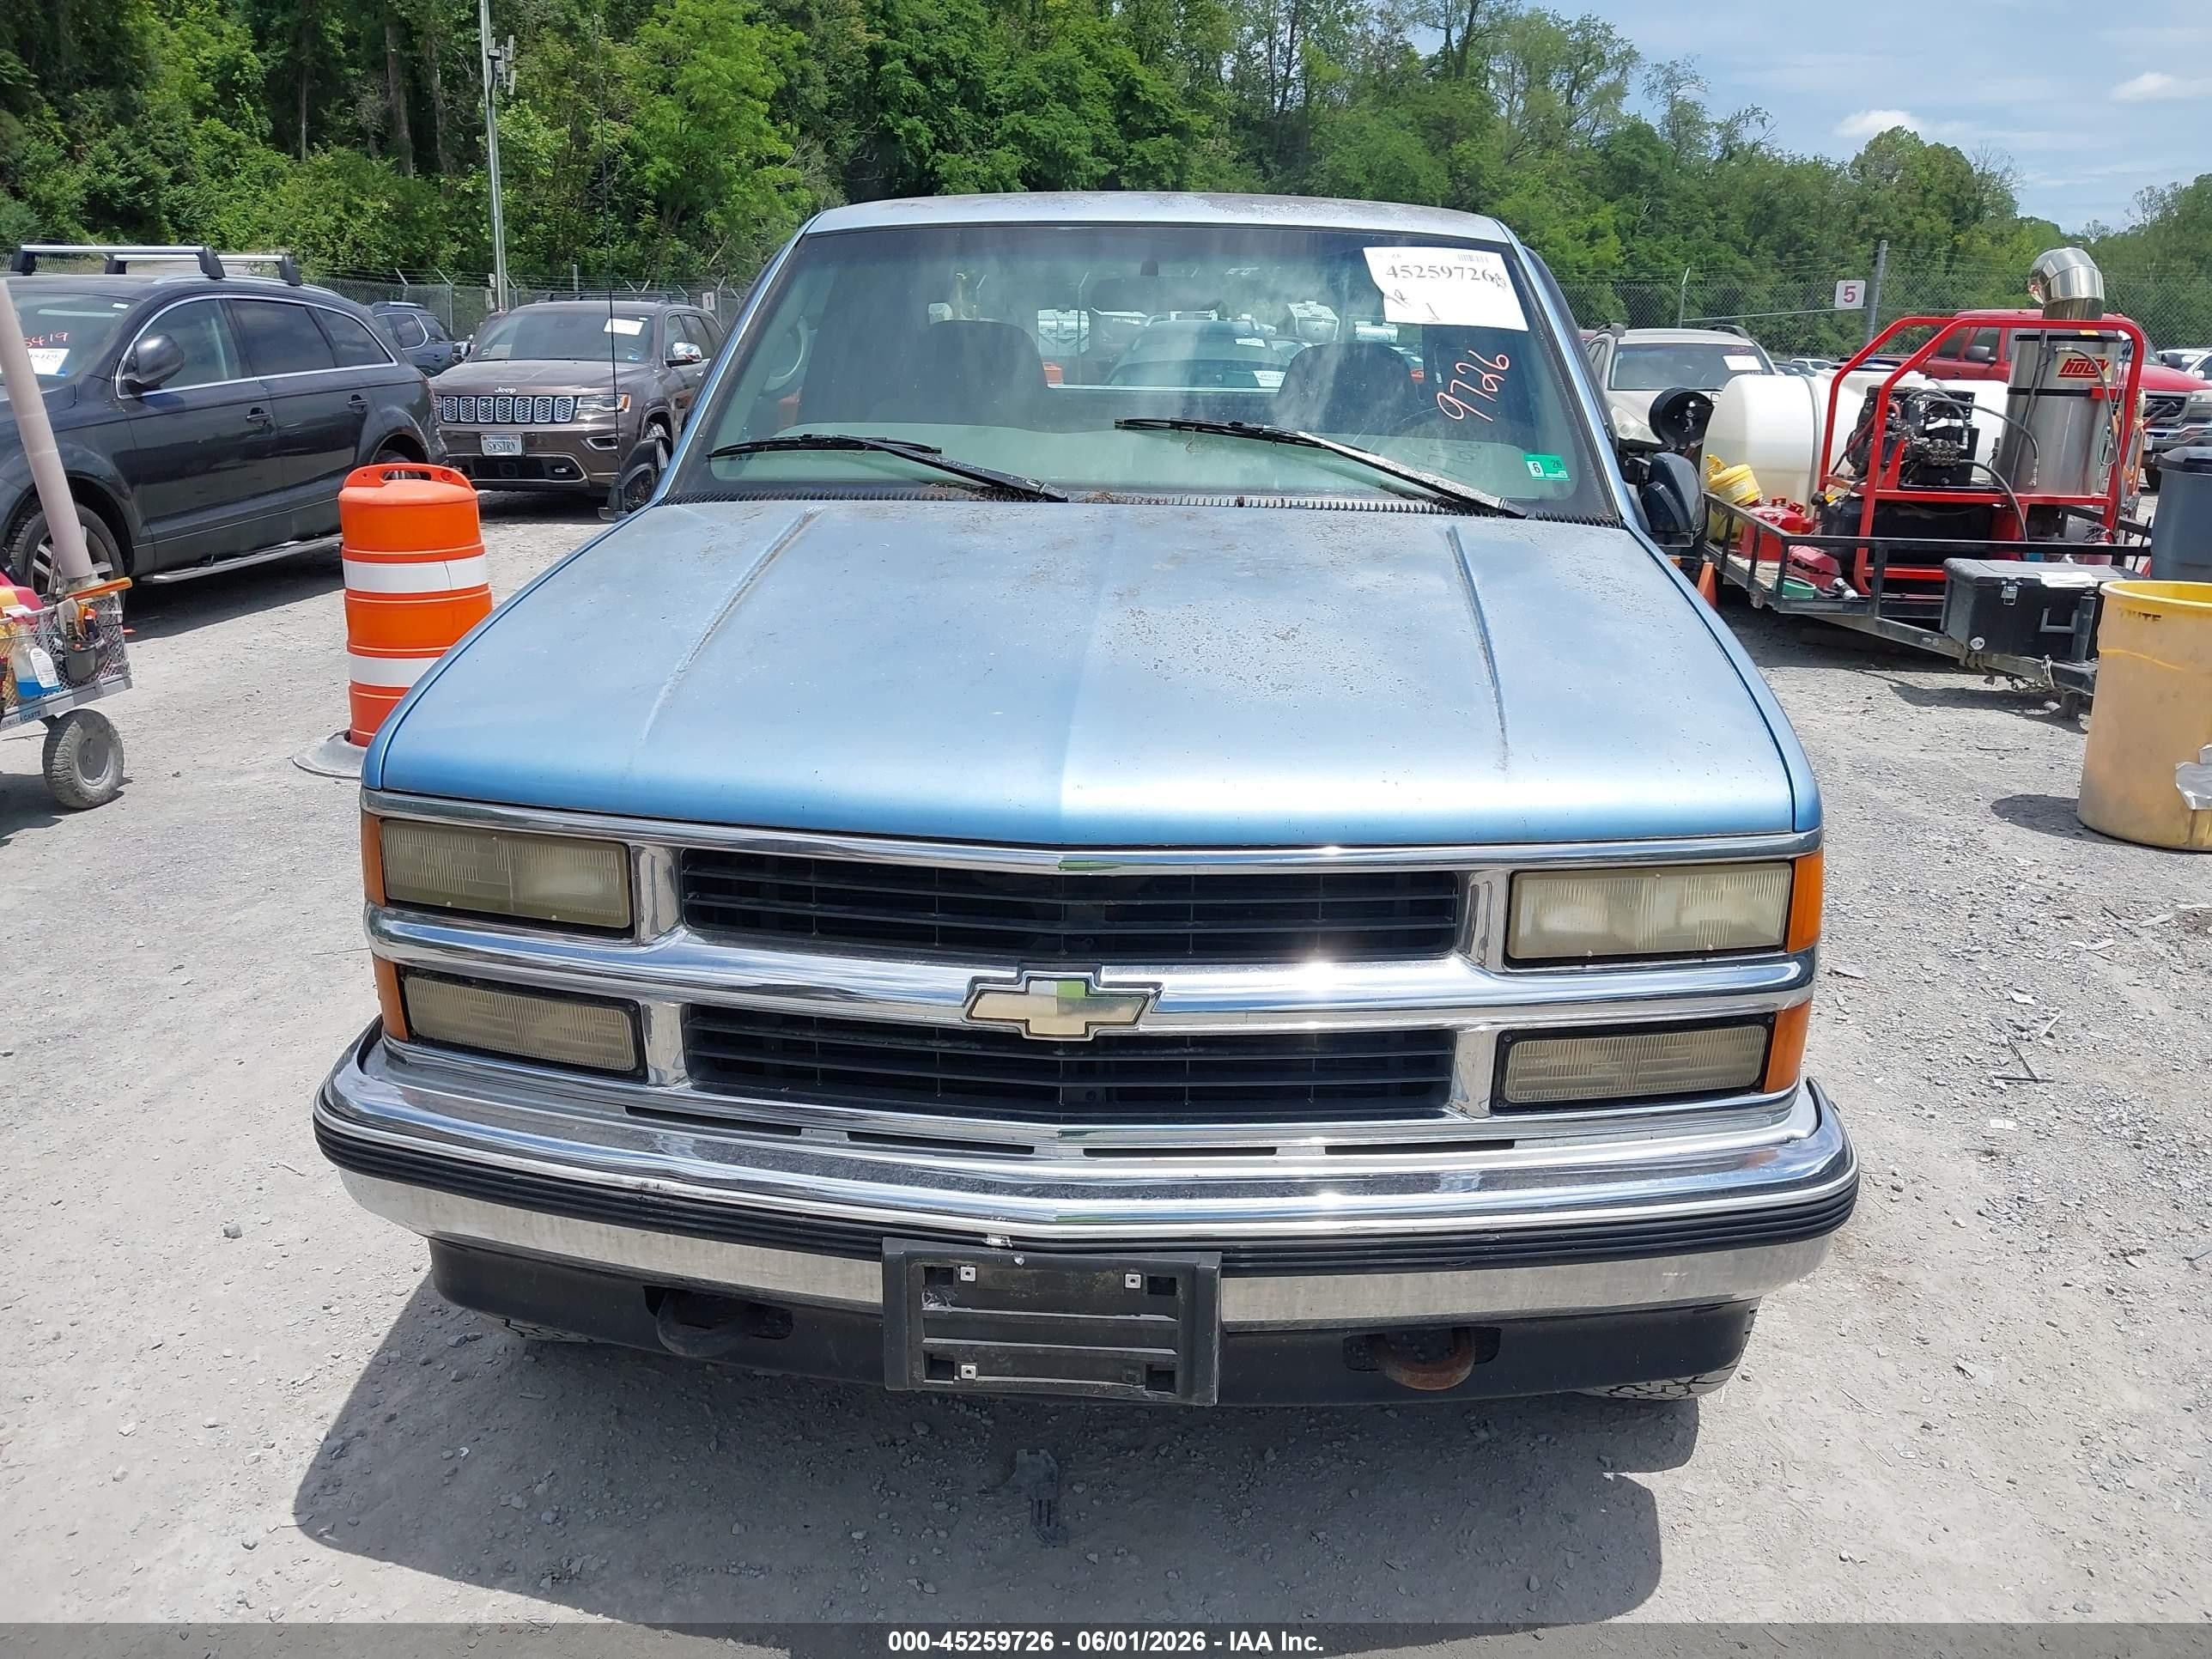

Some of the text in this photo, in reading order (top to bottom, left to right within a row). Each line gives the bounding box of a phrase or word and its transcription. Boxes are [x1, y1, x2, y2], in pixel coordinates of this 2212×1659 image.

[1386, 264, 1492, 283] 45259726
[1843, 285, 1856, 303] 5
[1437, 349, 1510, 422] 9726
[1532, 462, 1541, 473] 6
